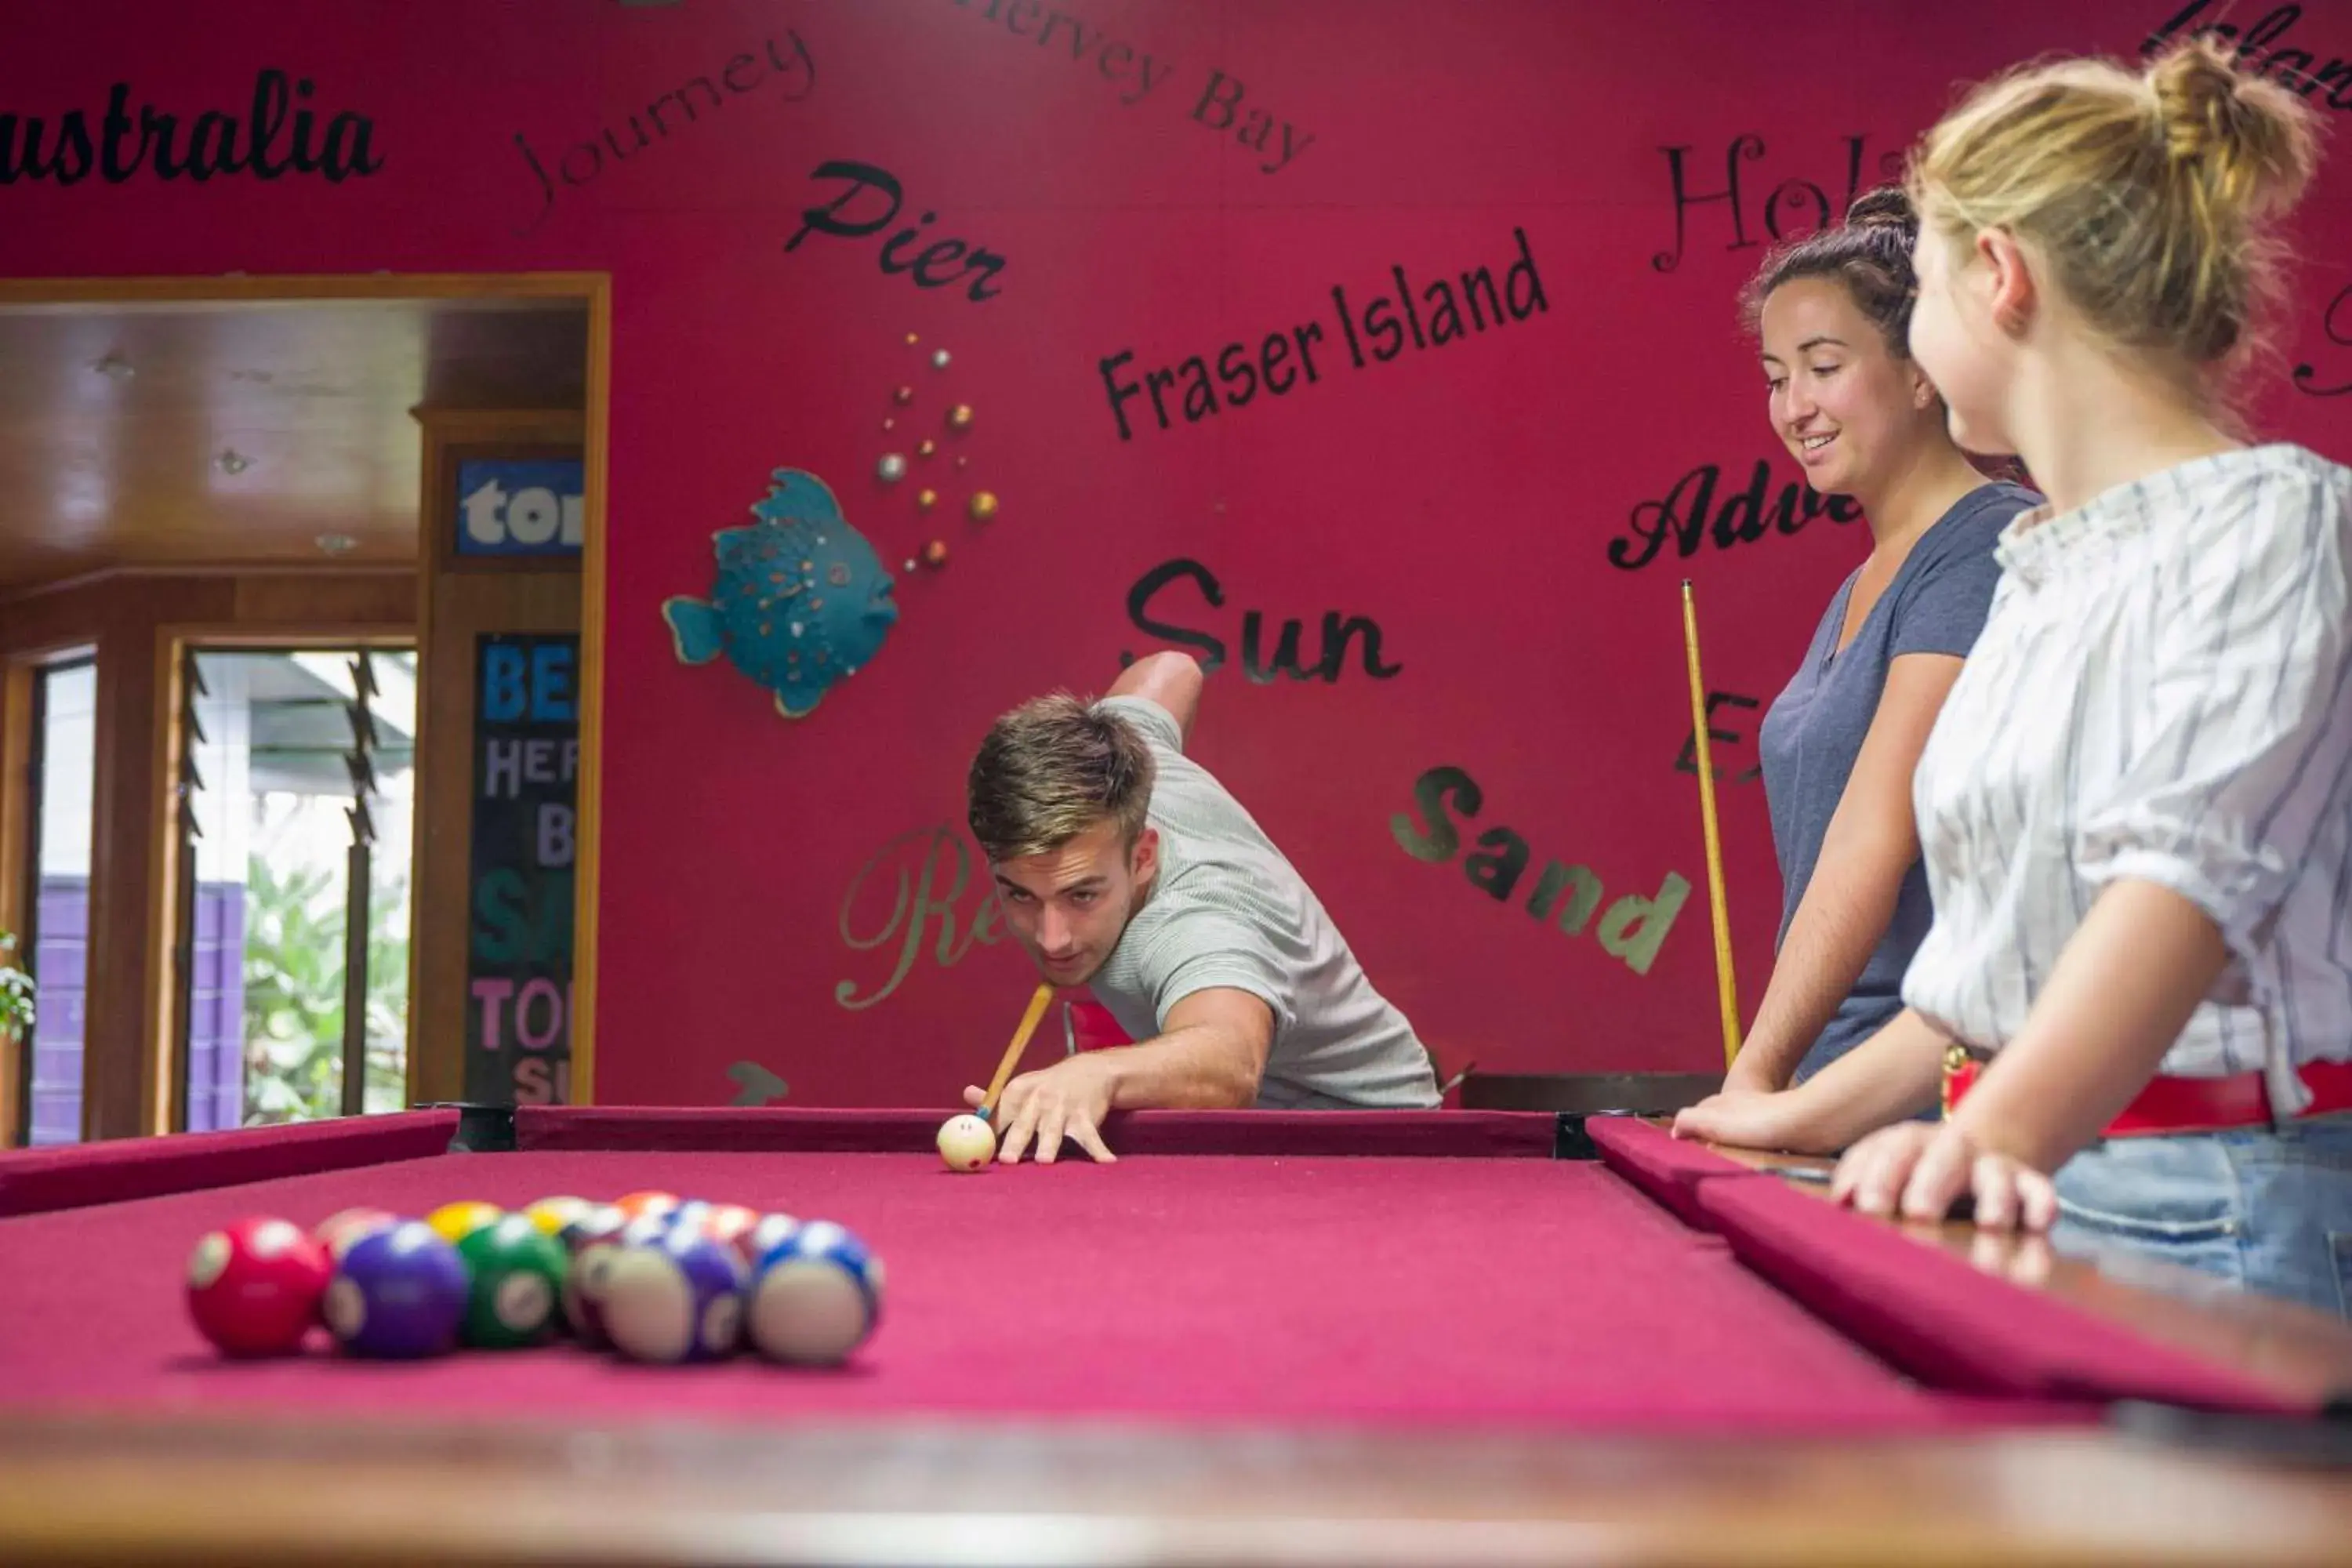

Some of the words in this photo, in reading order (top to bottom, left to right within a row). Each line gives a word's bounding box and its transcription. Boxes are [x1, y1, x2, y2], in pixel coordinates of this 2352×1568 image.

[0, 67, 384, 186] ustralia
[510, 29, 815, 238] Journey
[1191, 69, 1316, 175] Bay
[785, 161, 1007, 302] Pier
[1652, 132, 1905, 272] Hol
[1099, 320, 1323, 441] Fraser
[1331, 227, 1549, 369] Island
[485, 644, 579, 723] BE
[1120, 557, 1403, 685] Sun
[1674, 691, 1762, 783] E
[1390, 766, 1692, 976] Sand
[472, 978, 573, 1051] TO
